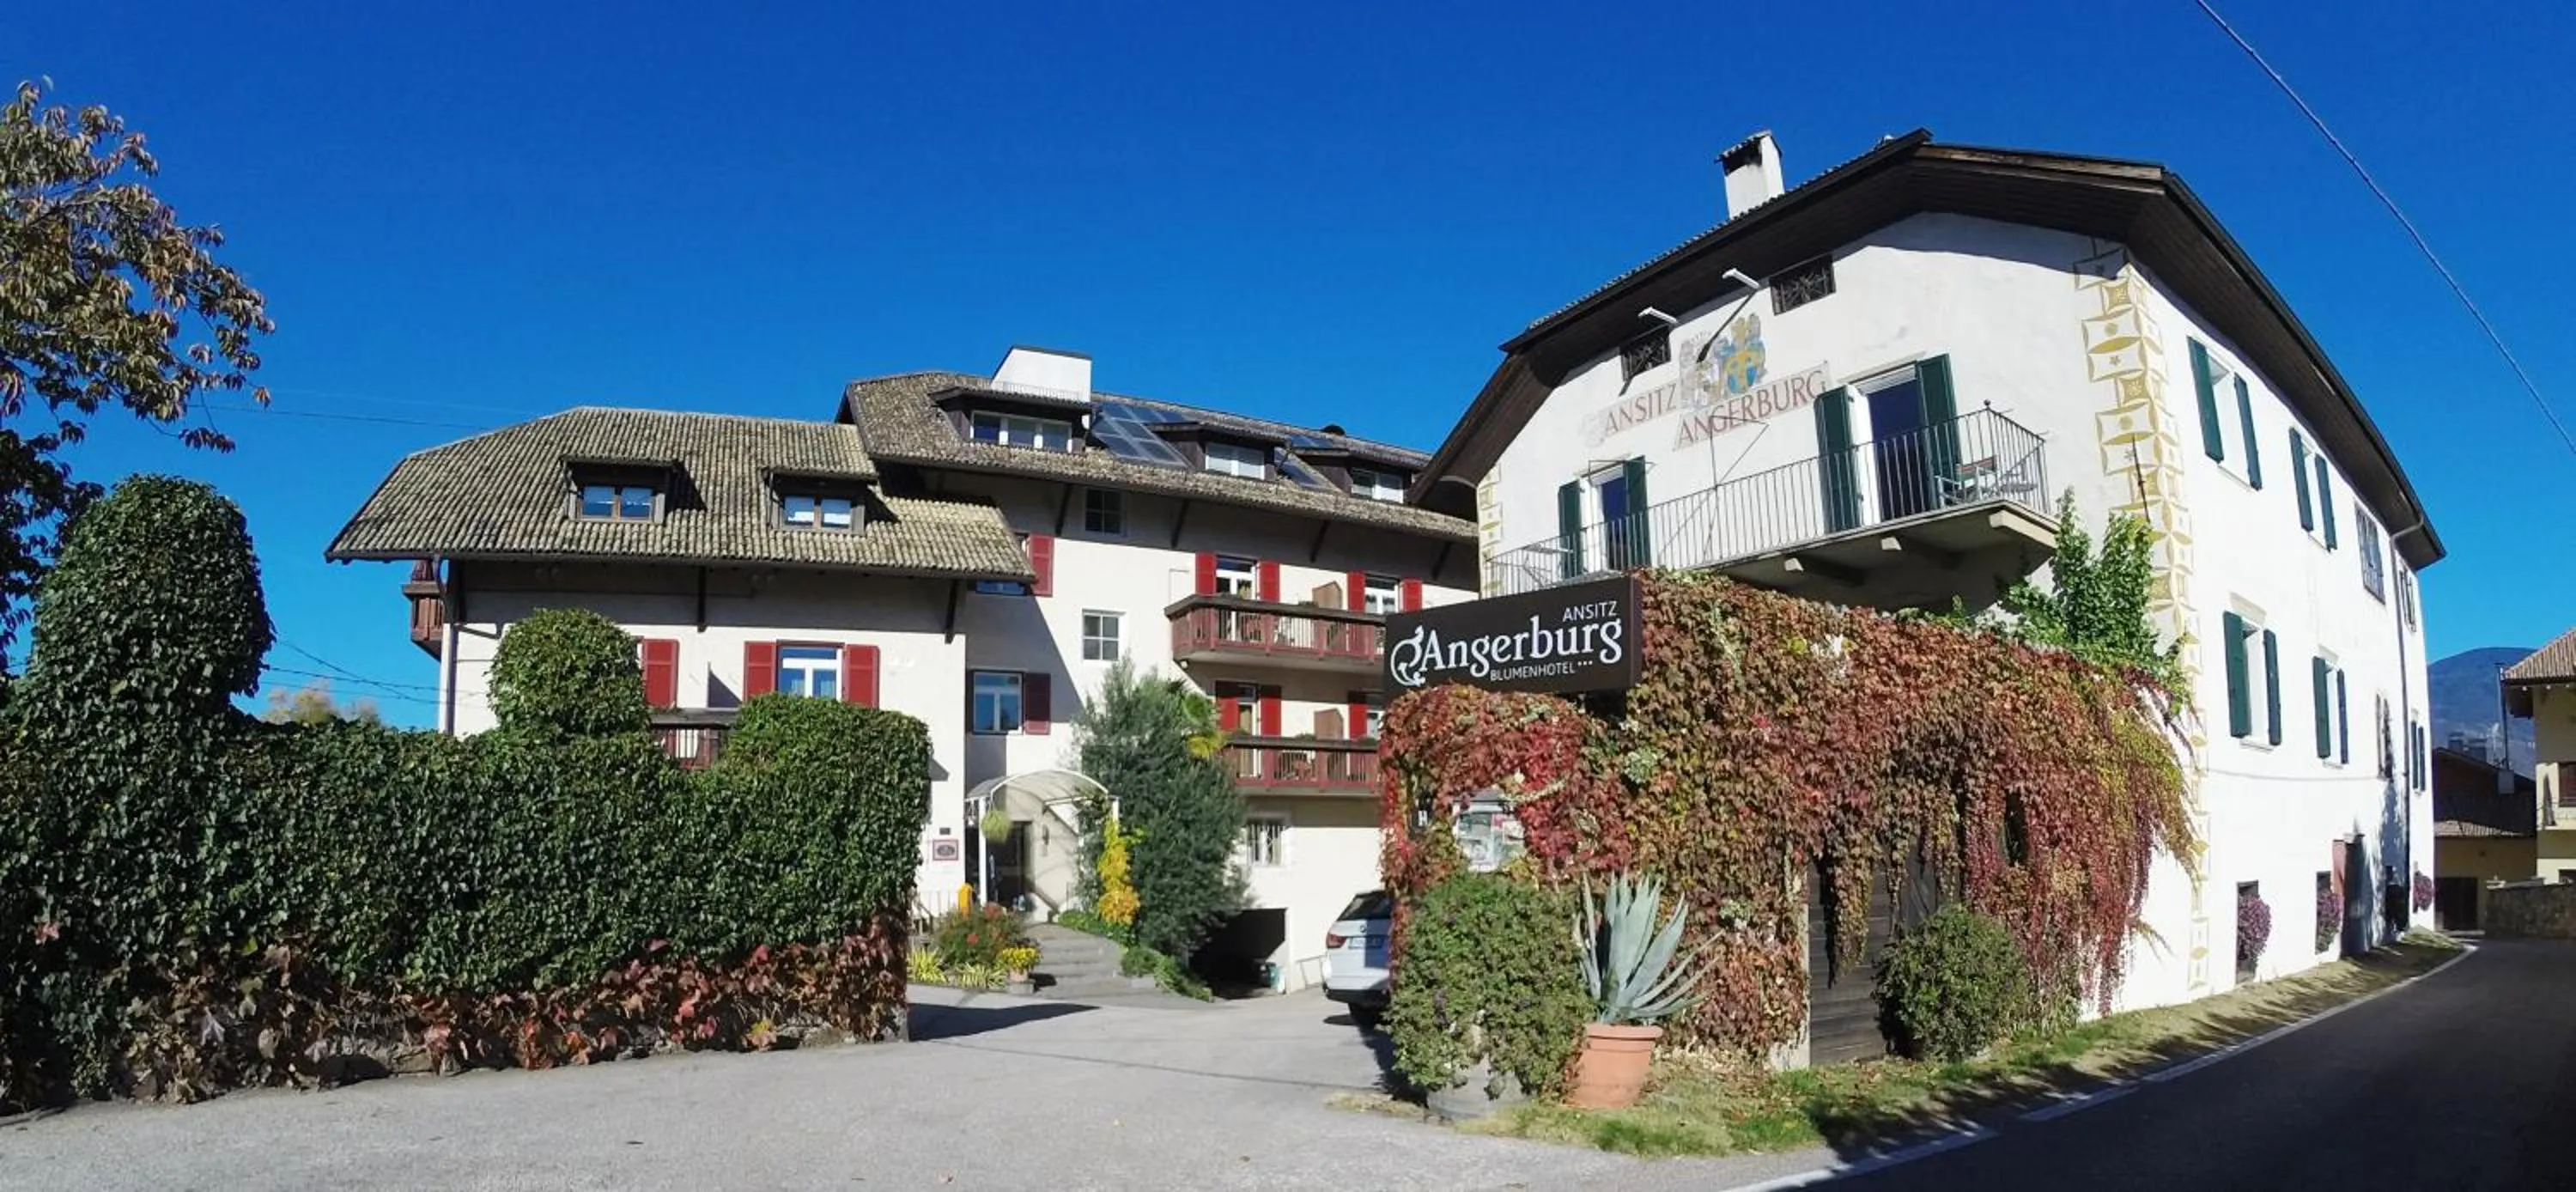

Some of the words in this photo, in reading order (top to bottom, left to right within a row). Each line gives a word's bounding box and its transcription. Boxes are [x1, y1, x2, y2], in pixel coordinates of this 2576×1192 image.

[1604, 384, 1677, 434] ANSITZ
[1677, 369, 1824, 445] ANGERBURG
[1562, 600, 1618, 623] ANSITZ
[1419, 616, 1622, 678] Angerburg
[1490, 661, 1576, 682] BLUMENHOTEL
